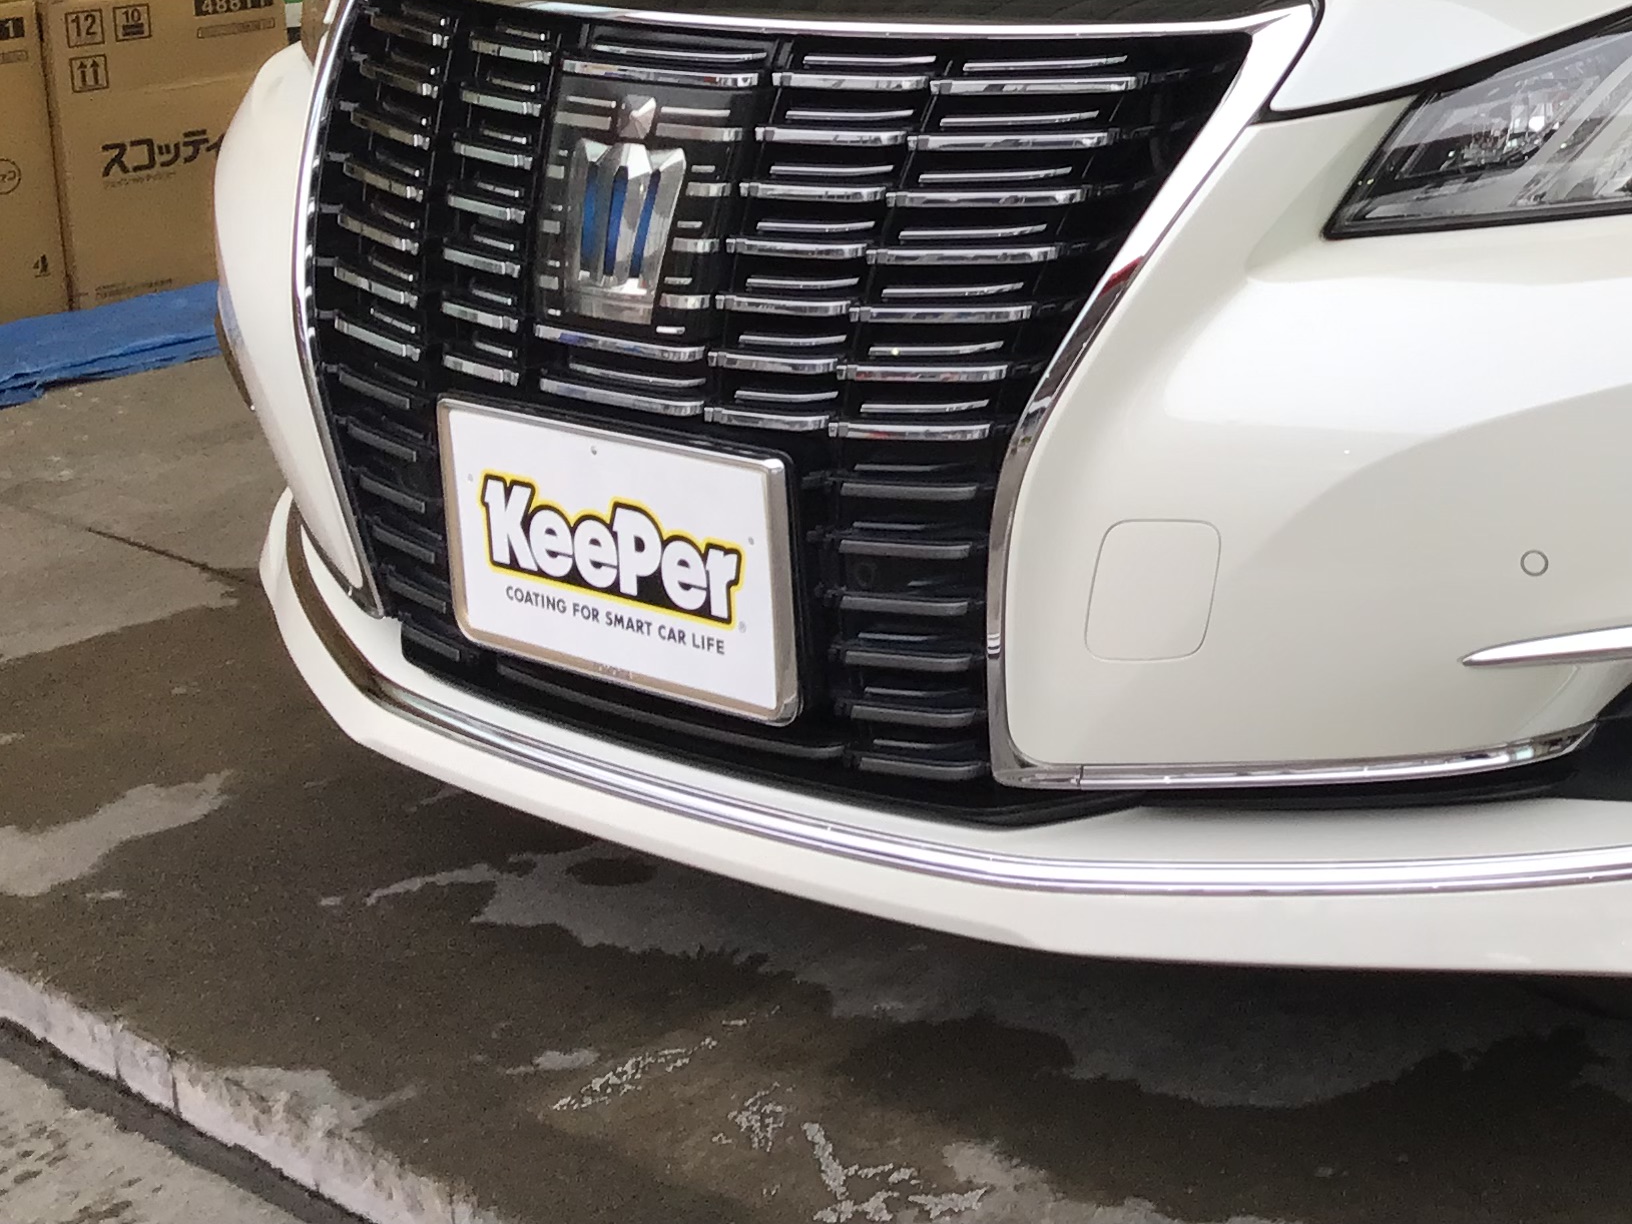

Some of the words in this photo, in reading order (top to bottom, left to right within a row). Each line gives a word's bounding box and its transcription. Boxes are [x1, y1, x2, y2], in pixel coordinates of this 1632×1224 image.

[71, 13, 97, 38] 12
[122, 8, 141, 23] 10
[482, 471, 743, 627] KeePer
[505, 585, 568, 615] COATING
[572, 602, 600, 624] FOR
[604, 610, 652, 637] SMART
[657, 624, 687, 646] CAR
[691, 632, 726, 656] LIFE
